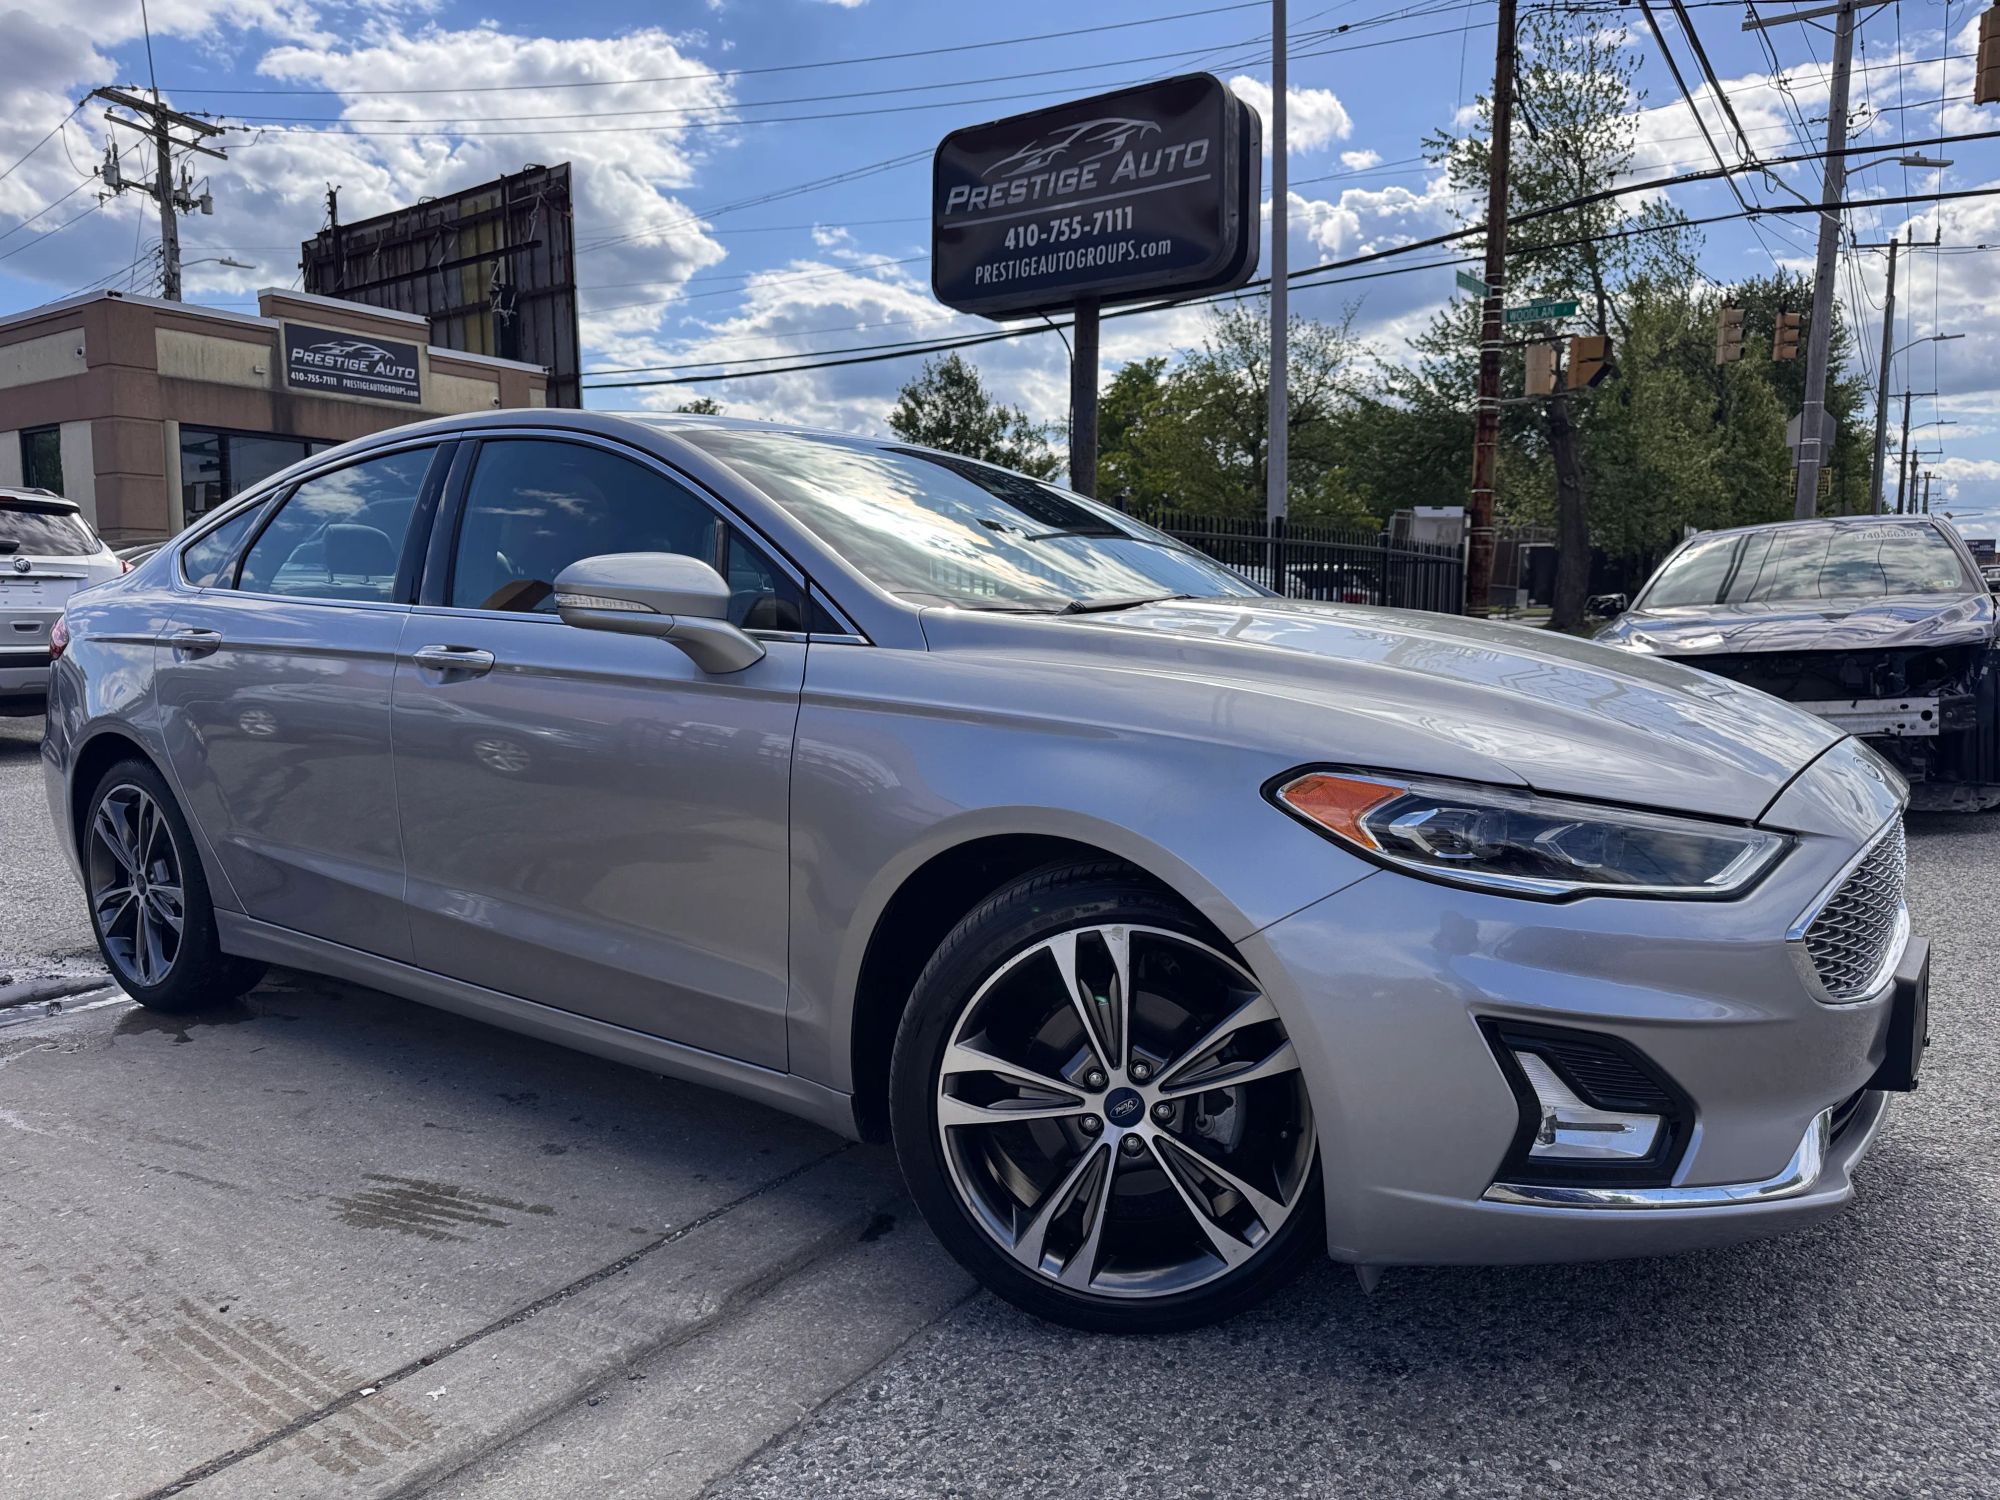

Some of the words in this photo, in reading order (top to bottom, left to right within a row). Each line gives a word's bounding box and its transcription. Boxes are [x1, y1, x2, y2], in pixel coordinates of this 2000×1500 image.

[945, 162, 1101, 215] PRESTIGE
[1110, 138, 1210, 185] AUTO
[1004, 206, 1134, 250] 410-755-7111
[975, 237, 1172, 285] PRESTIGEAUTOGROUPS.com
[290, 370, 338, 386] 410-755-7111
[343, 378, 419, 397] PRESTIGEAUTOGROUPS.com
[291, 348, 369, 372] PRESTIGE
[373, 362, 415, 379] AUTO
